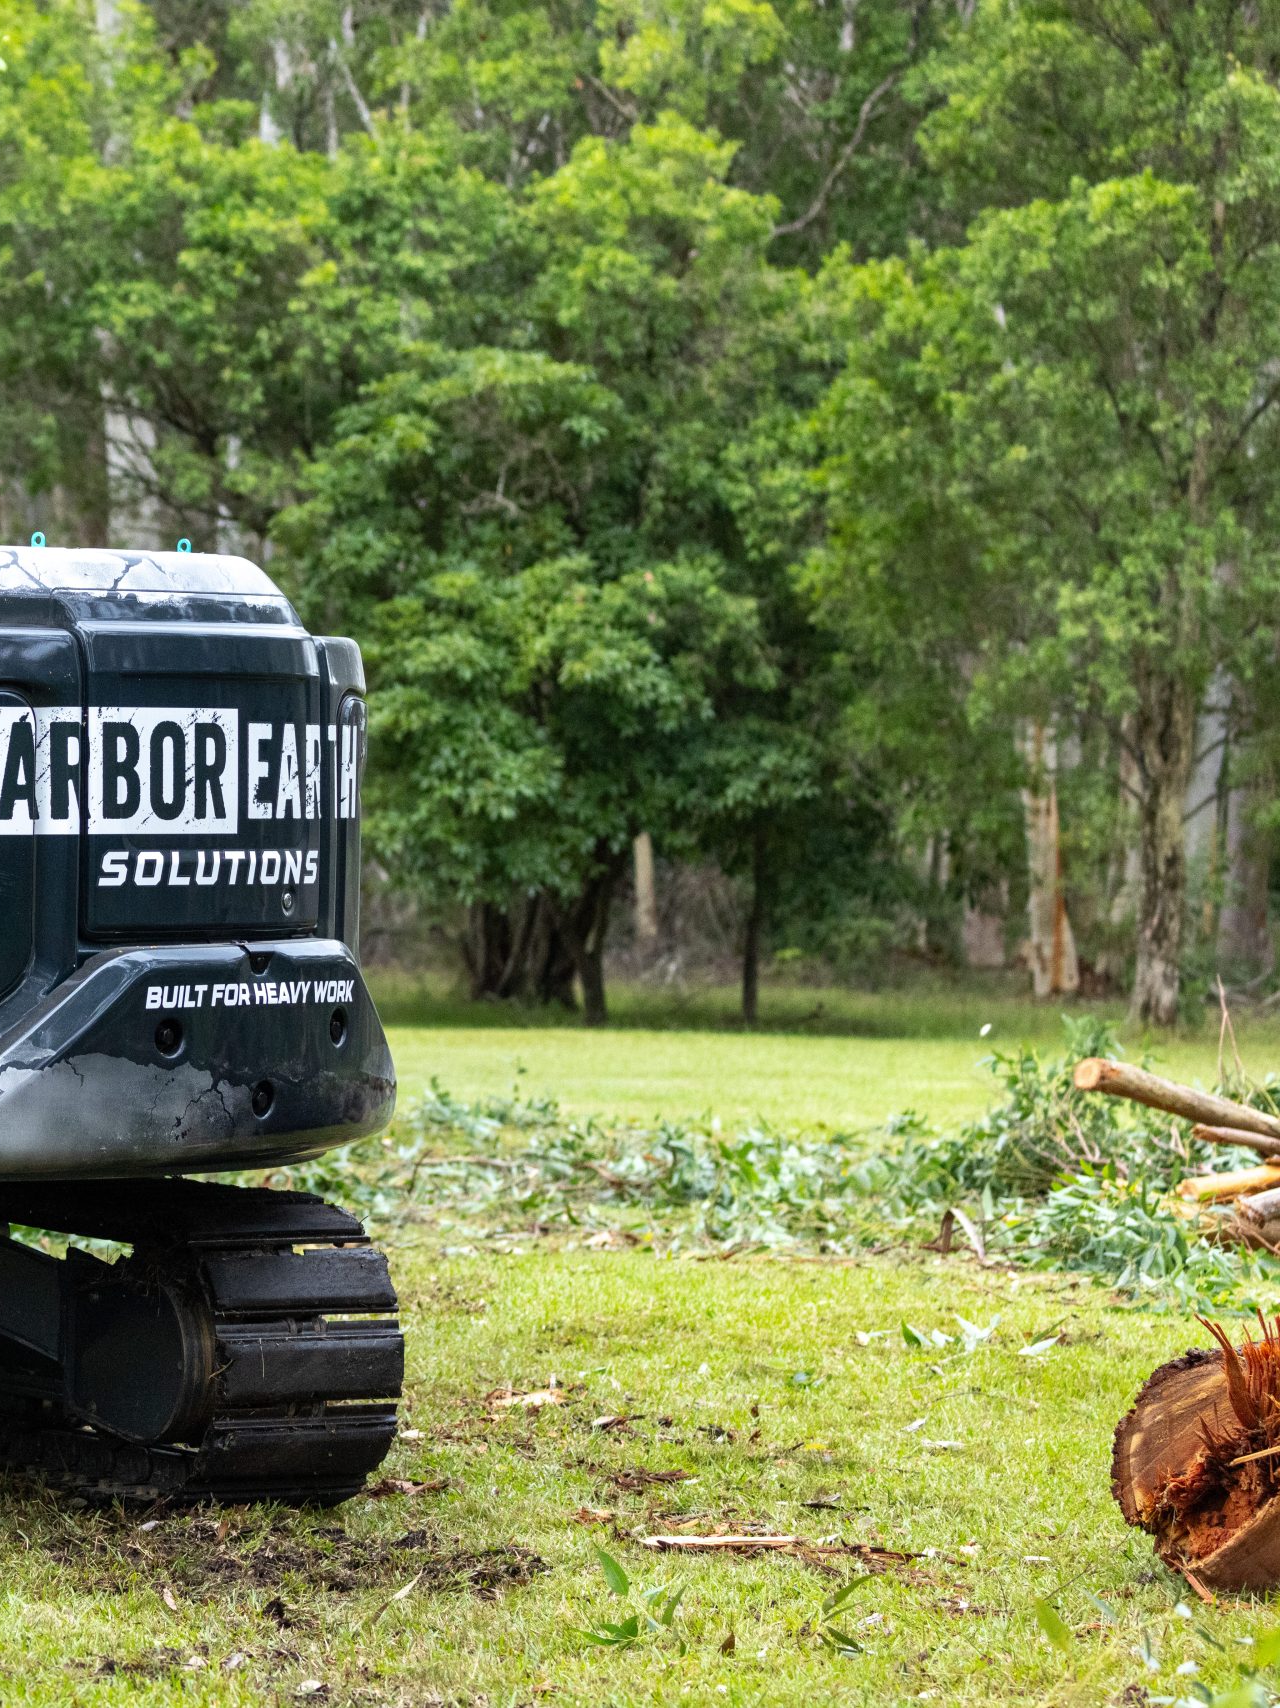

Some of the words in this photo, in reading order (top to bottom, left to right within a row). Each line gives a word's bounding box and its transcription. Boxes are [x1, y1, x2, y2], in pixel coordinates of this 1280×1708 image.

[98, 850, 319, 887] SOLUTIONS
[145, 985, 208, 1009] BUILT
[211, 983, 251, 1007] FOR
[254, 980, 311, 1005] HEAVY
[314, 980, 355, 1003] WORK
